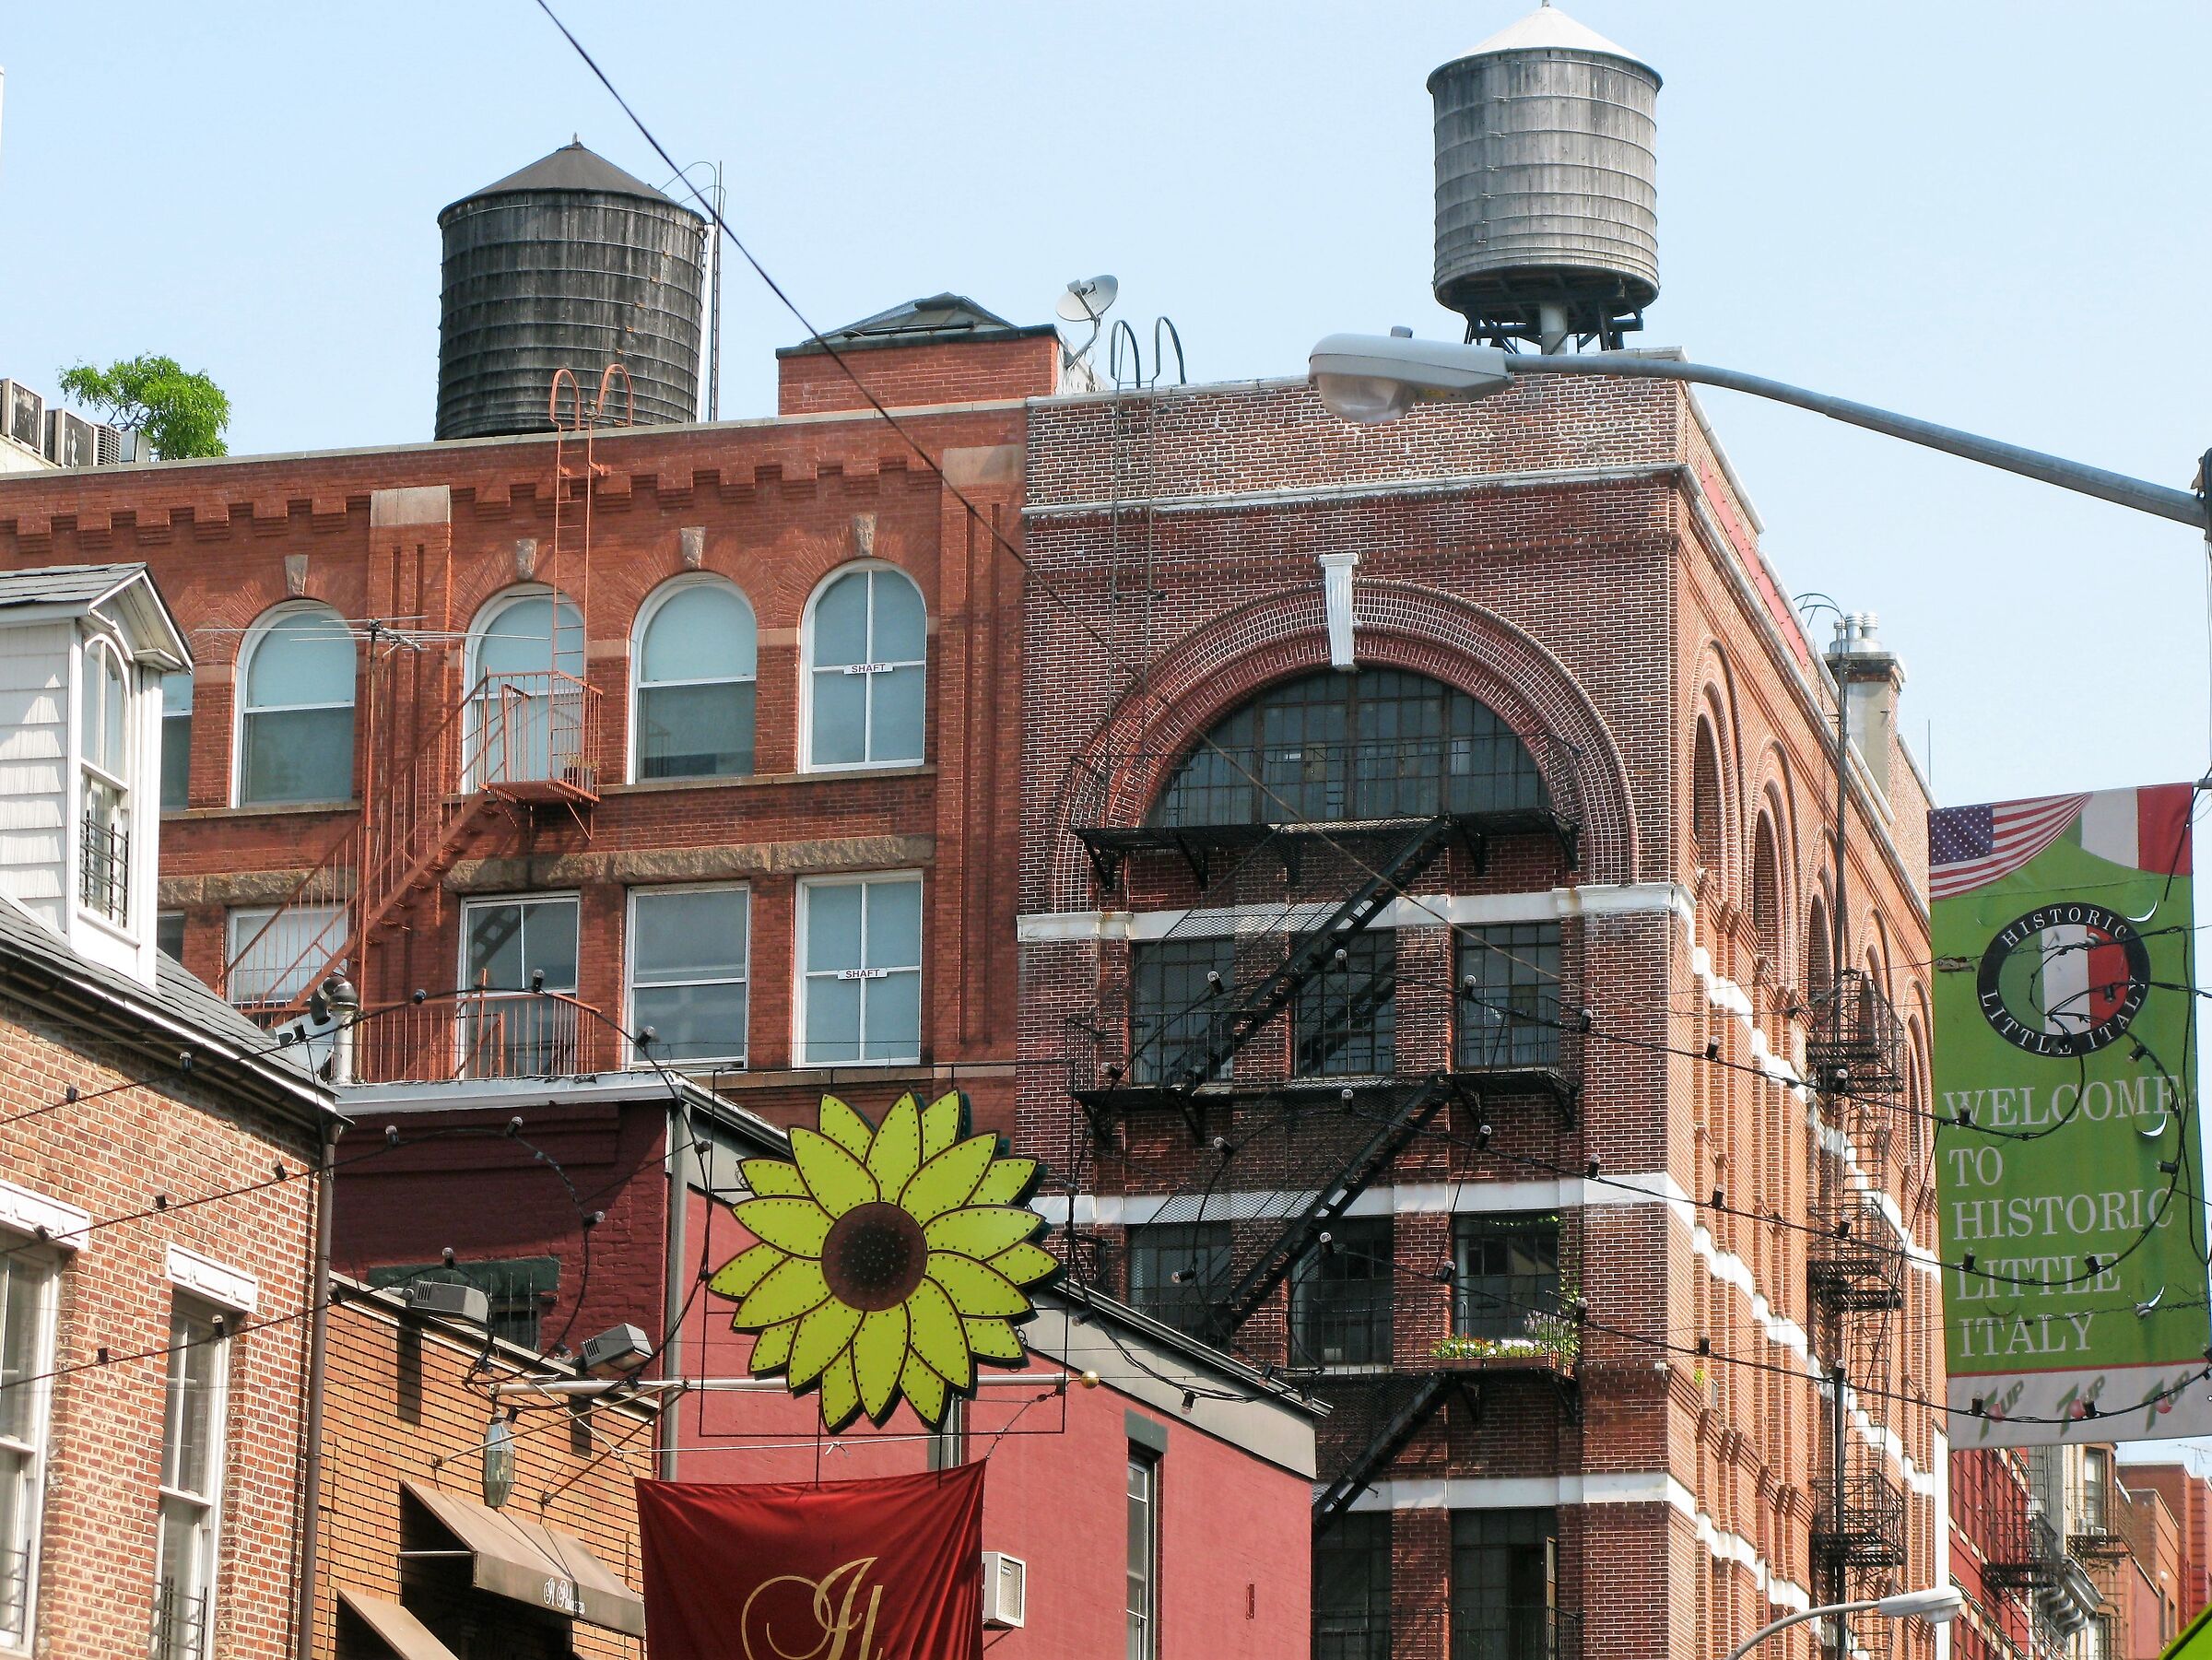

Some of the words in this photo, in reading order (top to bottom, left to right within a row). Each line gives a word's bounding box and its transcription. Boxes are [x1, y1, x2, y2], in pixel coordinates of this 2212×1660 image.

[852, 664, 886, 673] SHAFT
[2003, 907, 2128, 948] HISTORIC
[845, 969, 880, 979] SHAFT
[2087, 975, 2146, 1049] ITALY
[1943, 1075, 2181, 1129] WELCOME
[1949, 1147, 2003, 1187] TO
[1952, 1187, 2173, 1241] HISTORIC
[1955, 1252, 2121, 1301] LITTLE
[1959, 1313, 2094, 1358] ITALY
